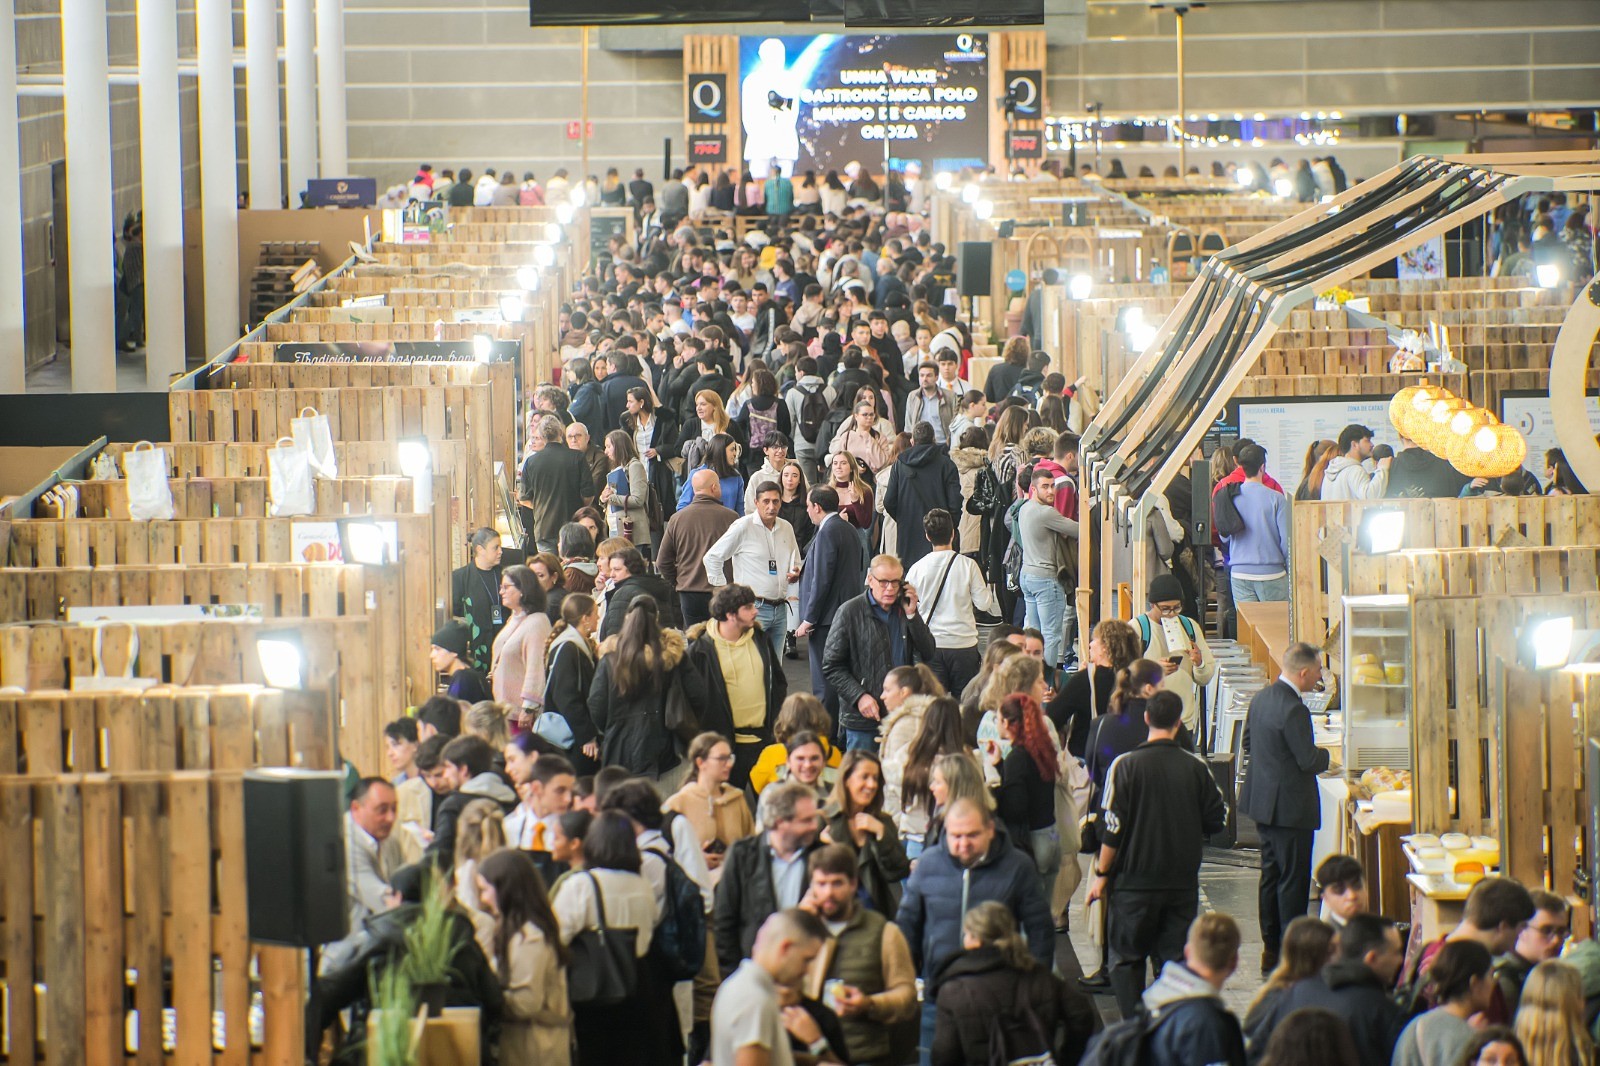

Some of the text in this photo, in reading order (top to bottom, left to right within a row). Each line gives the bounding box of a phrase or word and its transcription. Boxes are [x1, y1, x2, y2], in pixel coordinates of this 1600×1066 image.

[840, 69, 938, 84] UNHA VIAXE
[692, 80, 722, 118] Q
[933, 87, 978, 102] POLO
[812, 106, 875, 121] MUNDO
[902, 105, 967, 121] CARLOS
[860, 124, 919, 140] OROZA
